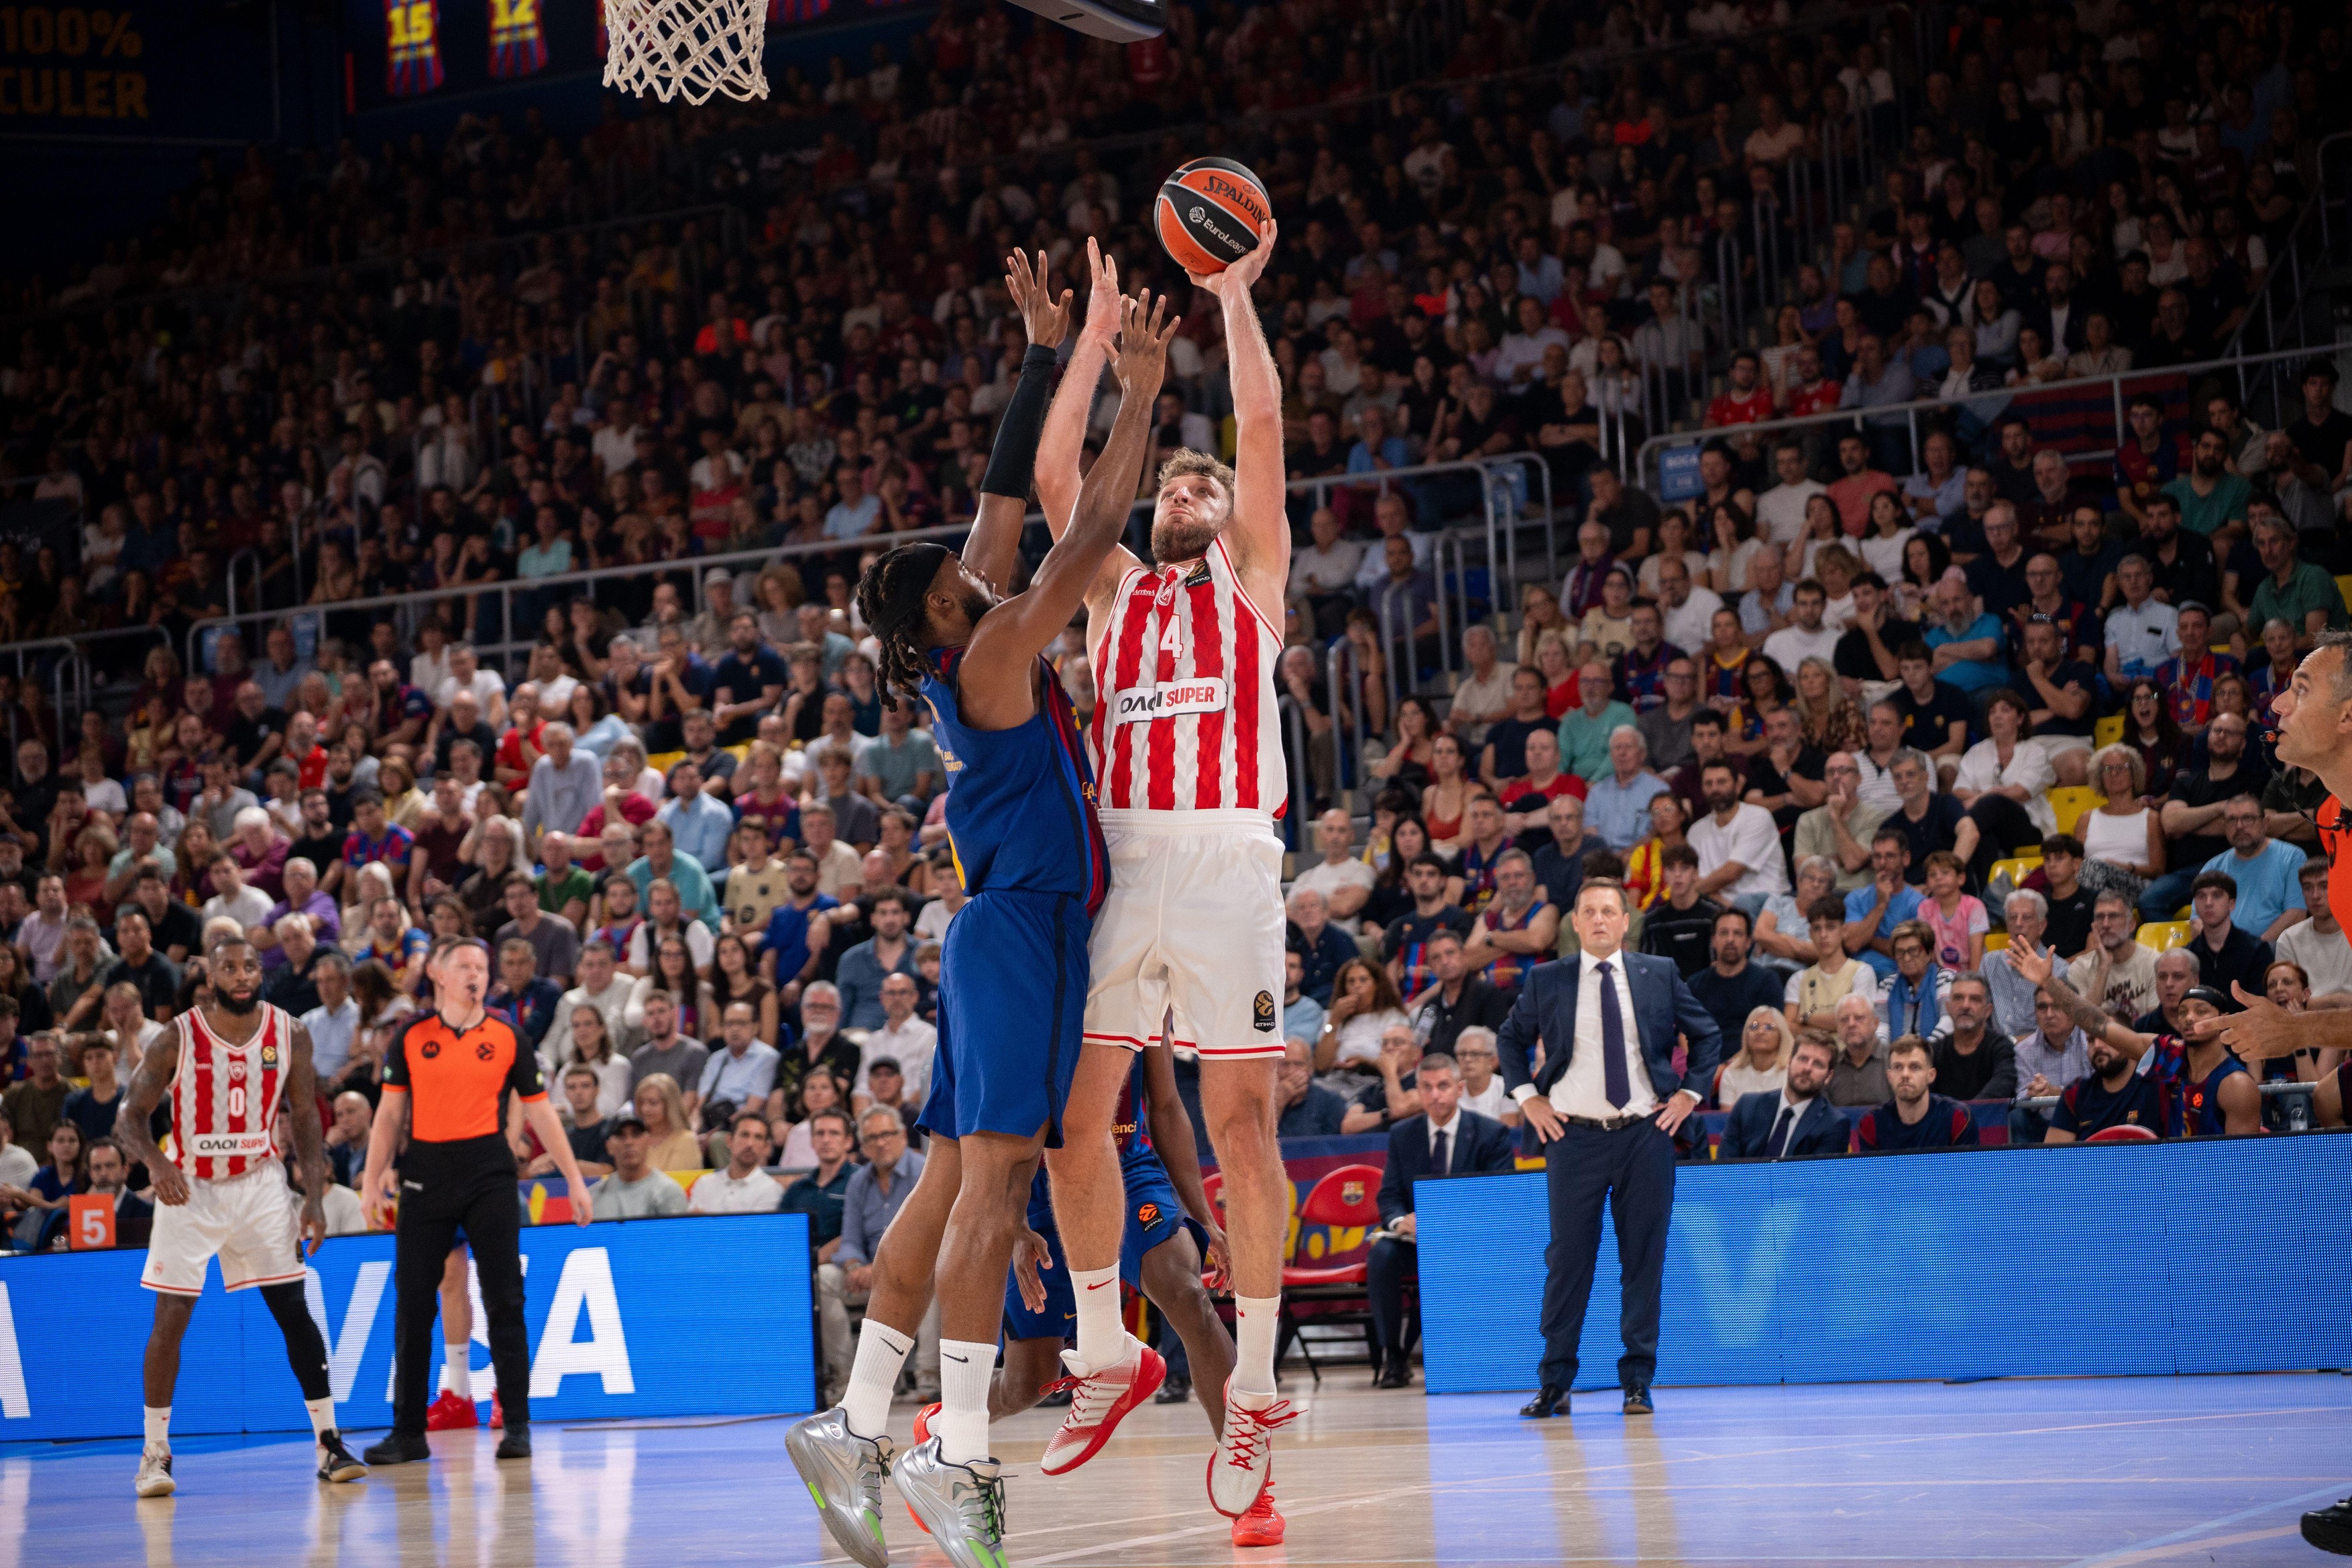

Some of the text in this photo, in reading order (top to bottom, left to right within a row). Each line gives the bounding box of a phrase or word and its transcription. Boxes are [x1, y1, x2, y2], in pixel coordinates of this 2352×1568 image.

[0, 5, 144, 59] 100%
[386, 1, 433, 45] 15
[0, 65, 150, 119] CULER
[1204, 176, 1269, 225] SPALDIN
[1203, 218, 1249, 254] EuroLeagu
[1166, 686, 1215, 707] SUPER
[229, 1086, 245, 1117] 0
[82, 1209, 106, 1245] 5
[304, 1247, 636, 1404] VA
